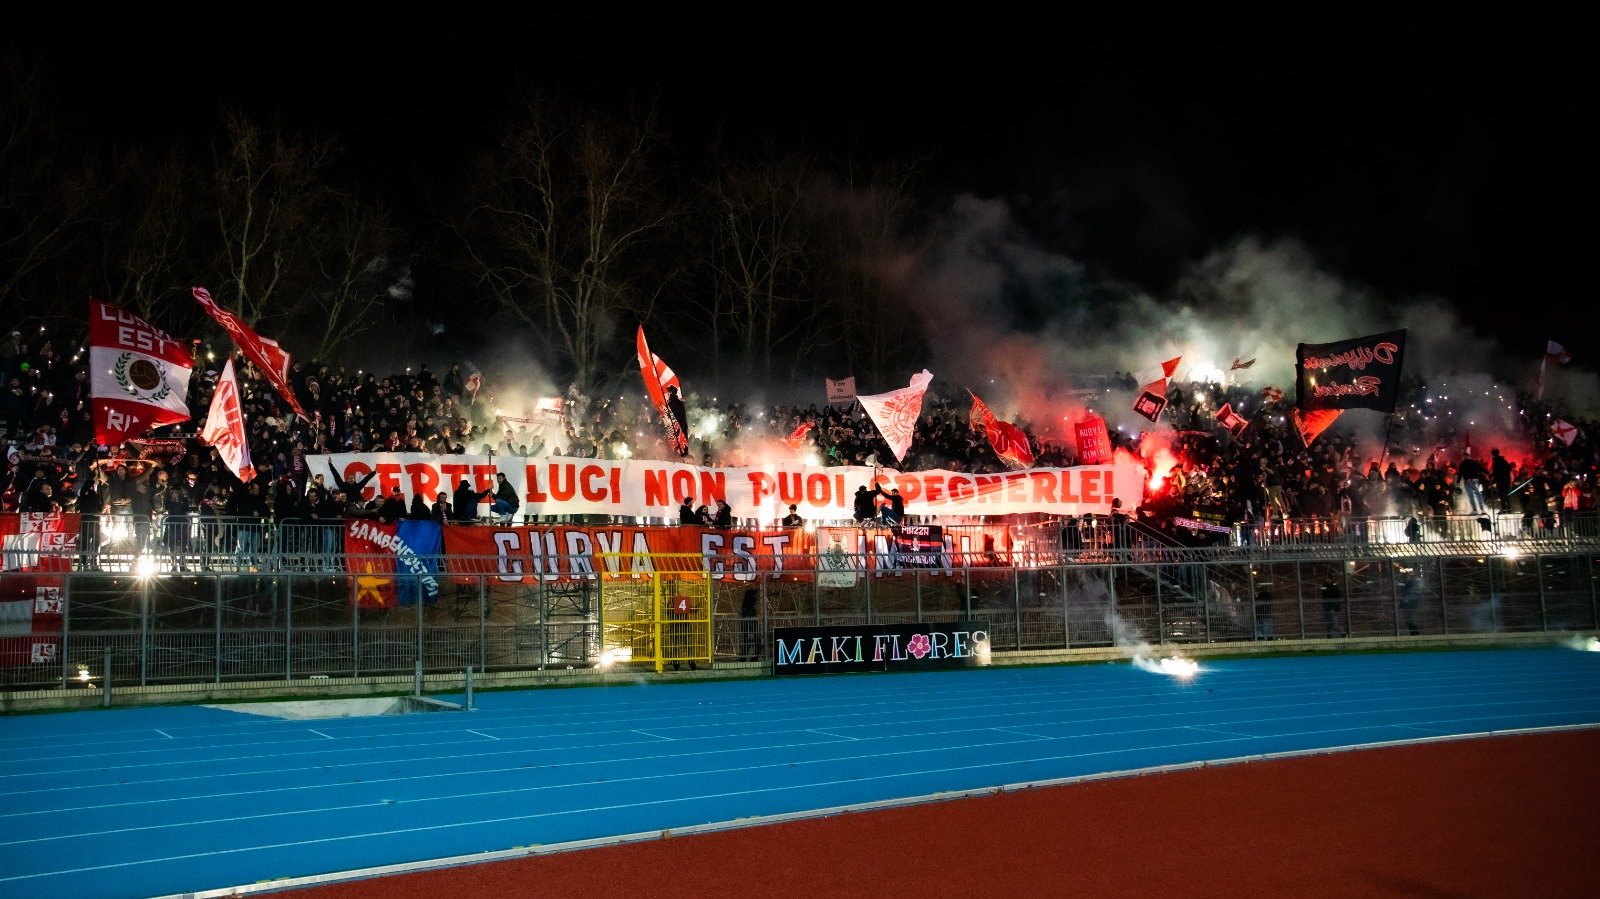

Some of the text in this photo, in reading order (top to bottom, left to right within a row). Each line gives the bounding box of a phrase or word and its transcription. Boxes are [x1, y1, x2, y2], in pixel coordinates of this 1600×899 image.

[118, 326, 167, 355] EST
[1083, 437, 1103, 448] LEVE
[1082, 447, 1108, 460] RIMINI
[343, 461, 497, 503] CERTE
[526, 464, 621, 503] LUCI
[644, 469, 726, 506] NON
[747, 472, 845, 508] PUOI
[869, 471, 1113, 507] SPEGNERLE!
[901, 526, 929, 536] PIAZZA
[493, 532, 655, 581] CURVA
[701, 533, 790, 581] EST
[679, 600, 686, 611] 4
[776, 636, 864, 665] MAKI
